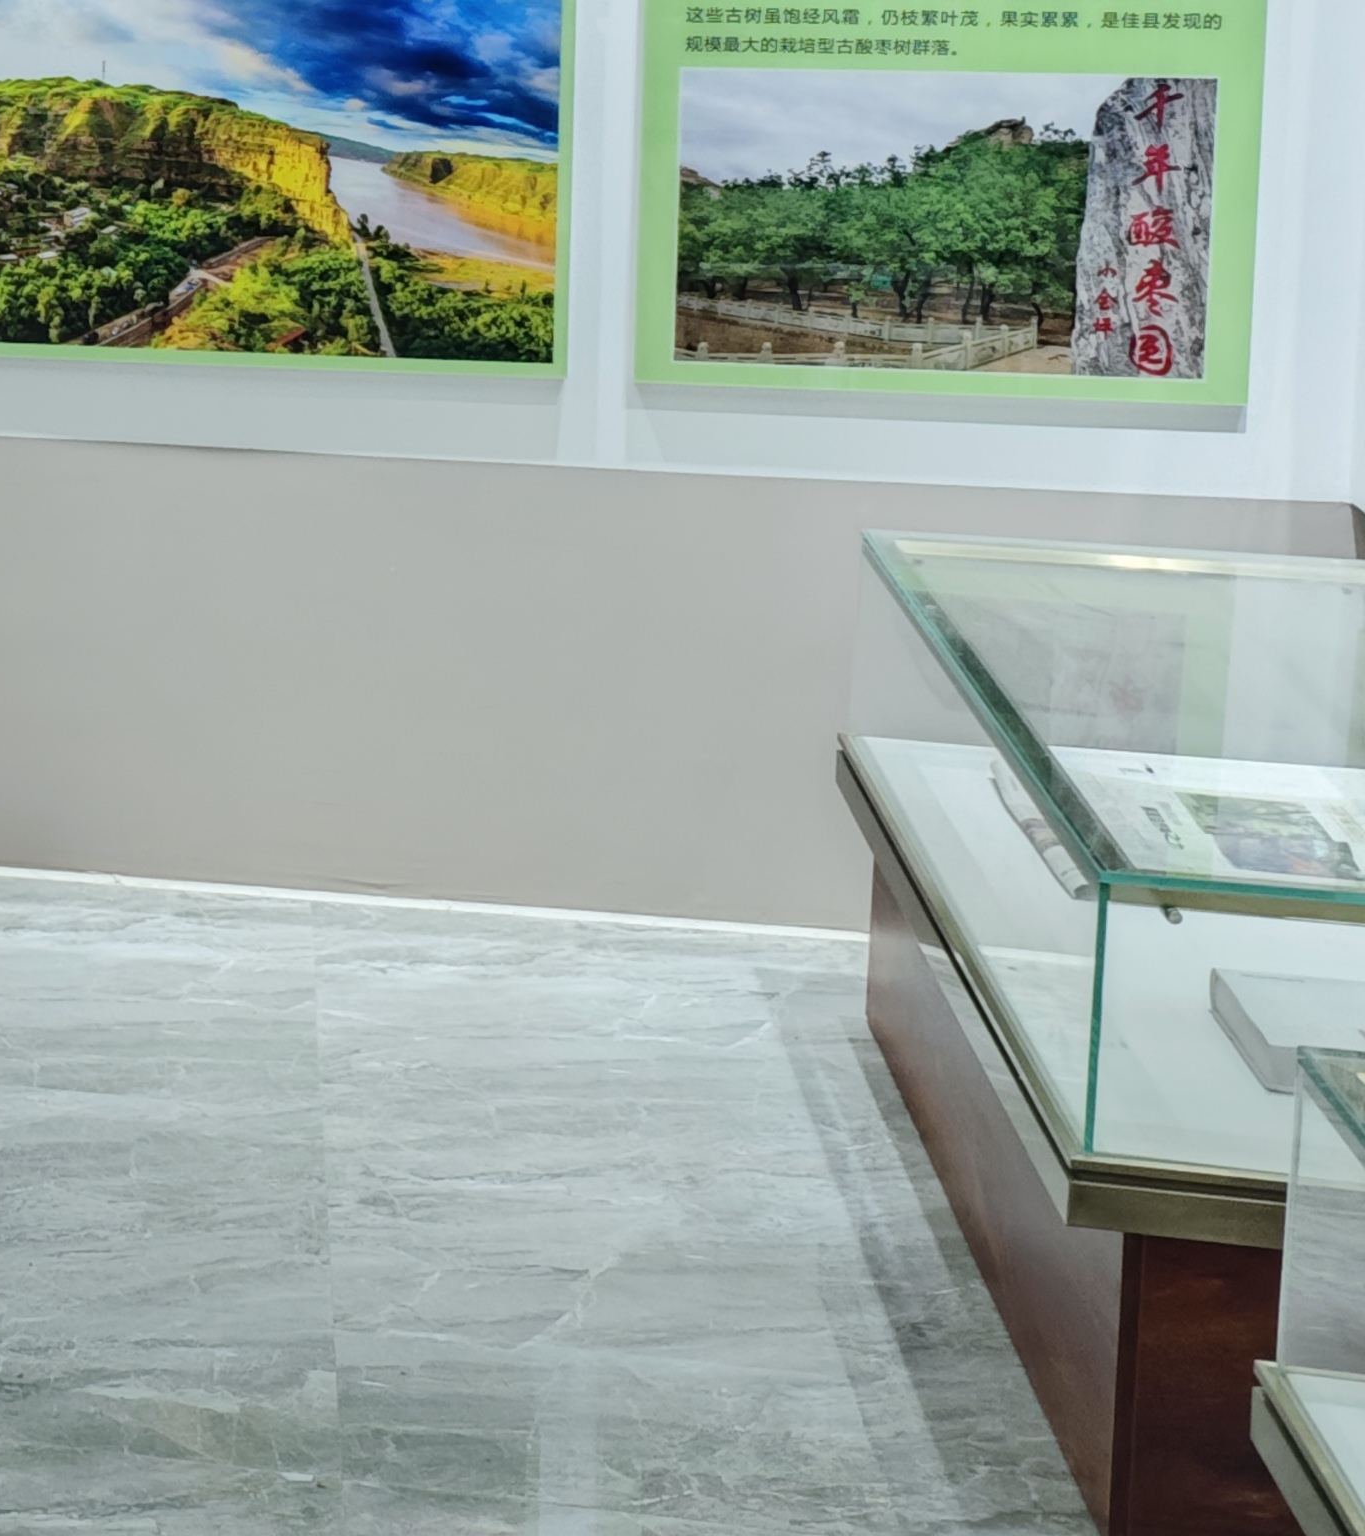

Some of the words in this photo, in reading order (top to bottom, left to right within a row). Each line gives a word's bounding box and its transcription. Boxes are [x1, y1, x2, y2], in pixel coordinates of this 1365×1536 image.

[685, 36, 959, 56] 规模最大的栽培型古酸枣树群落。
[1129, 83, 1185, 375] 千年酸枣园
